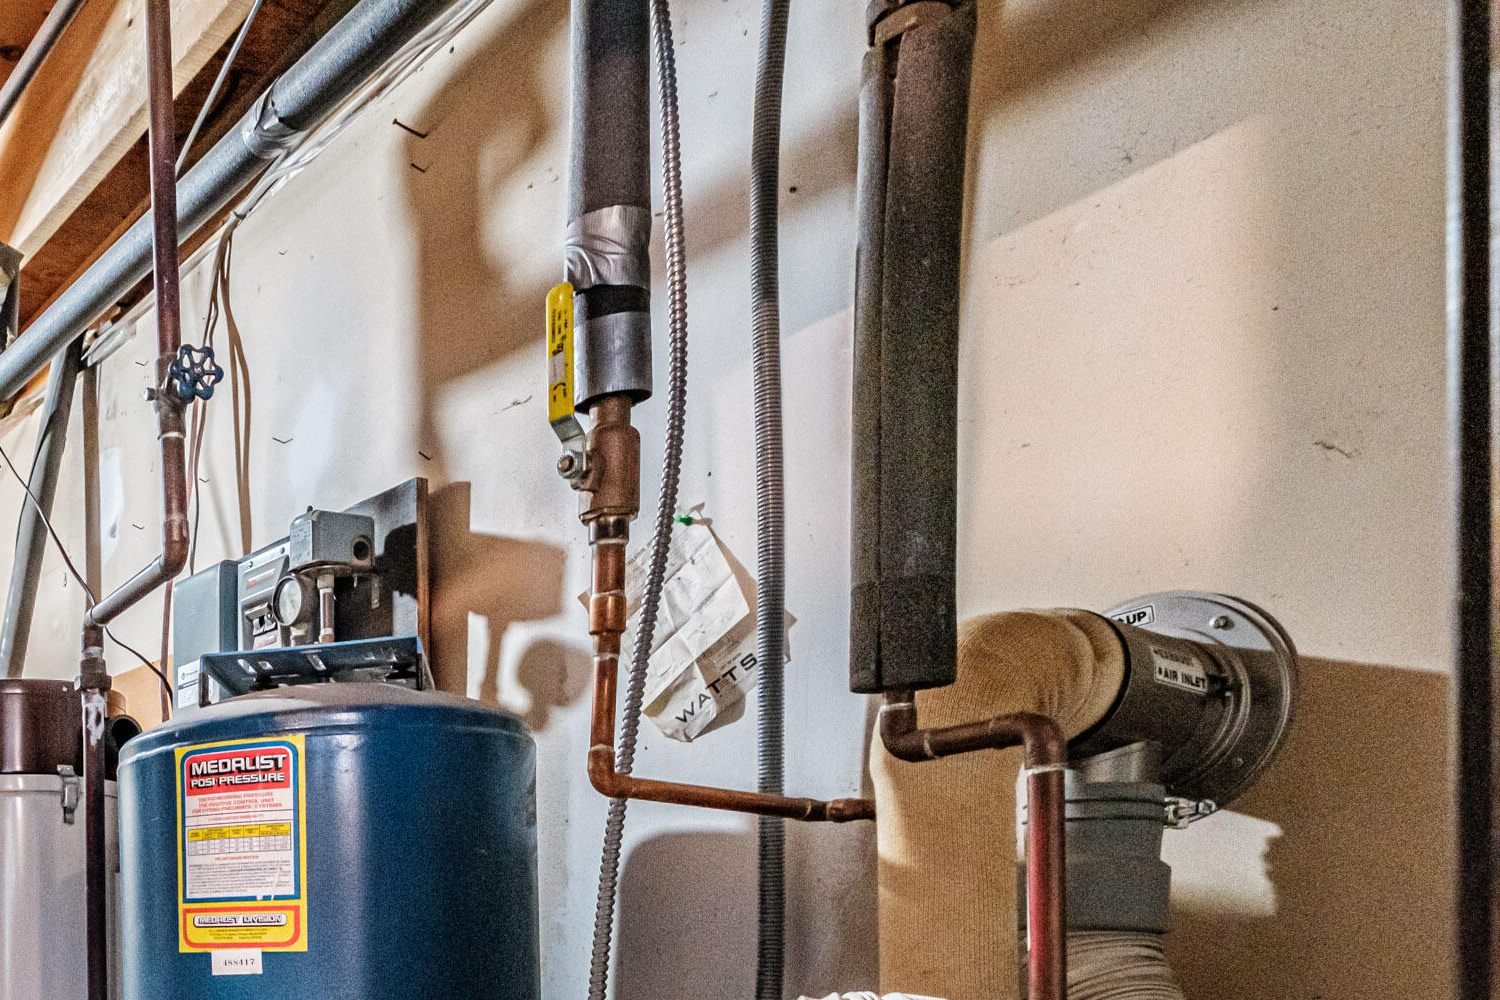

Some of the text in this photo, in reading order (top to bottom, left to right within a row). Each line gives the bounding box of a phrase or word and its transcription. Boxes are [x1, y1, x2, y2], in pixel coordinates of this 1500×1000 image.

[1126, 611, 1147, 625] UP
[675, 652, 758, 724] WATTS
[1163, 667, 1206, 689] AIR INLET
[190, 754, 288, 777] MEDALIST
[198, 914, 283, 925] MEDALIST DIVISION
